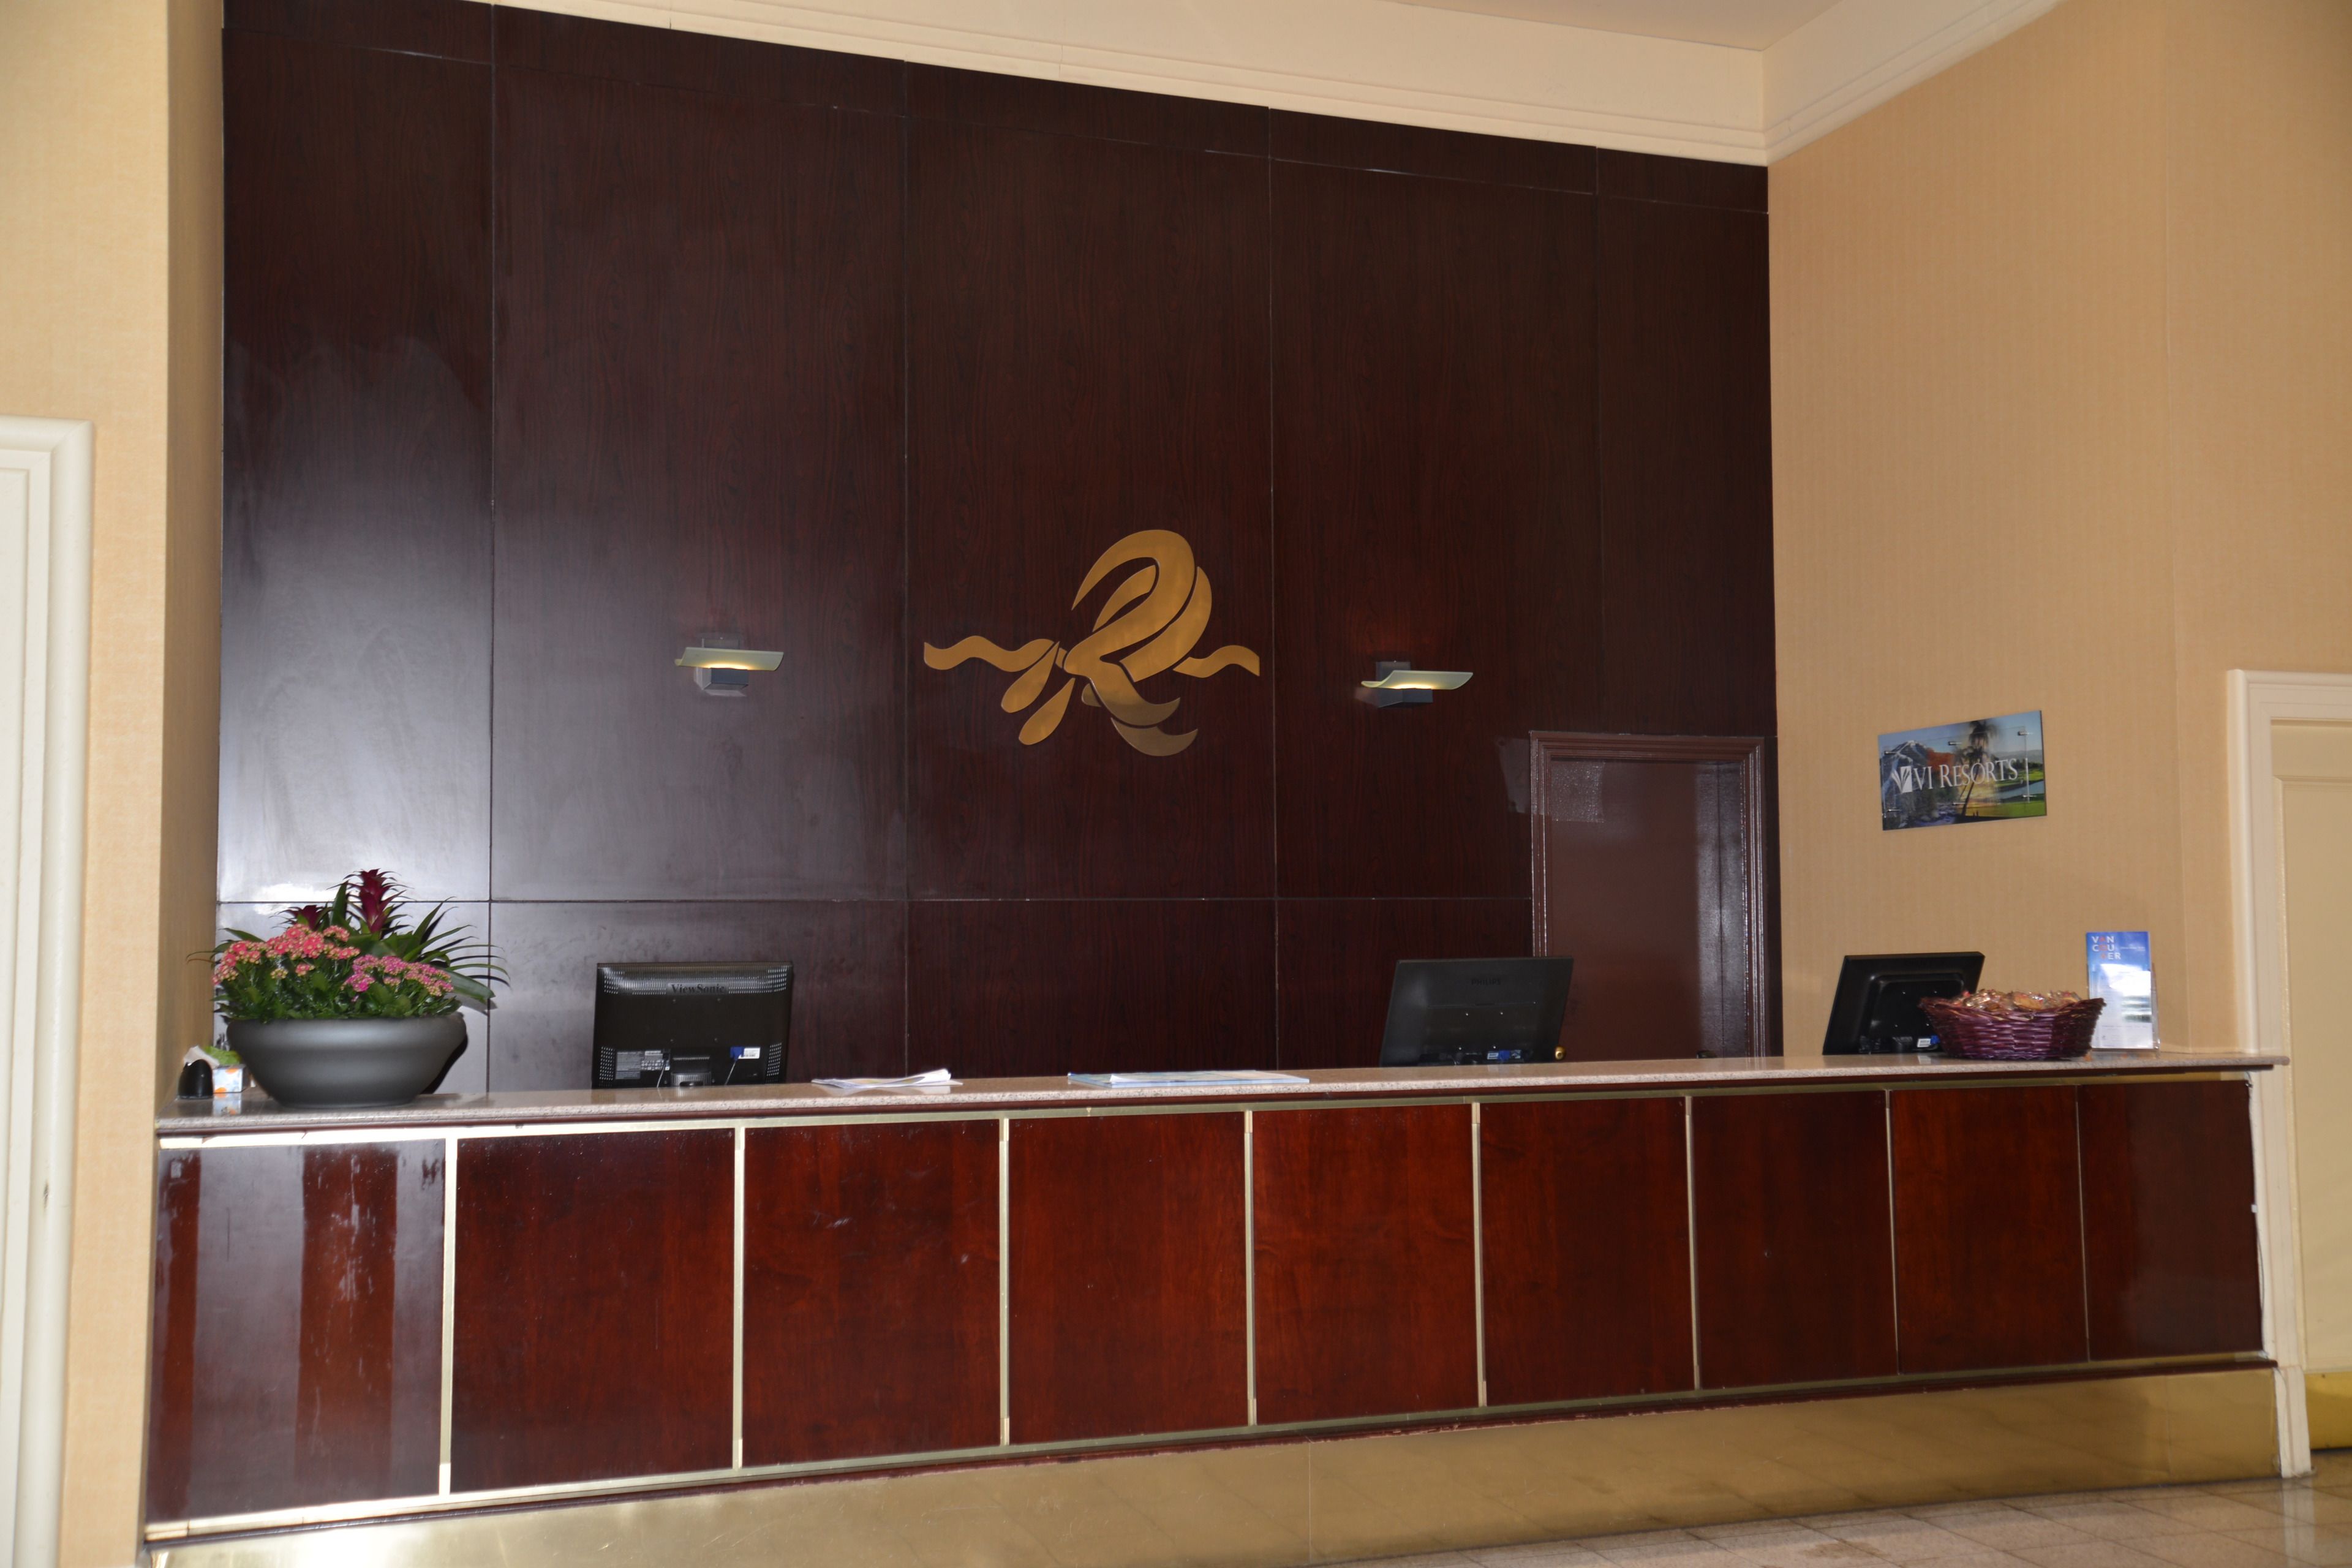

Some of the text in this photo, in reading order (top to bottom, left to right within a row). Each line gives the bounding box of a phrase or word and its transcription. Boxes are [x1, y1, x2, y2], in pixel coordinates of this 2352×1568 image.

[1913, 758, 2018, 791] VI RESORTS
[671, 983, 725, 993] ViewSonic
